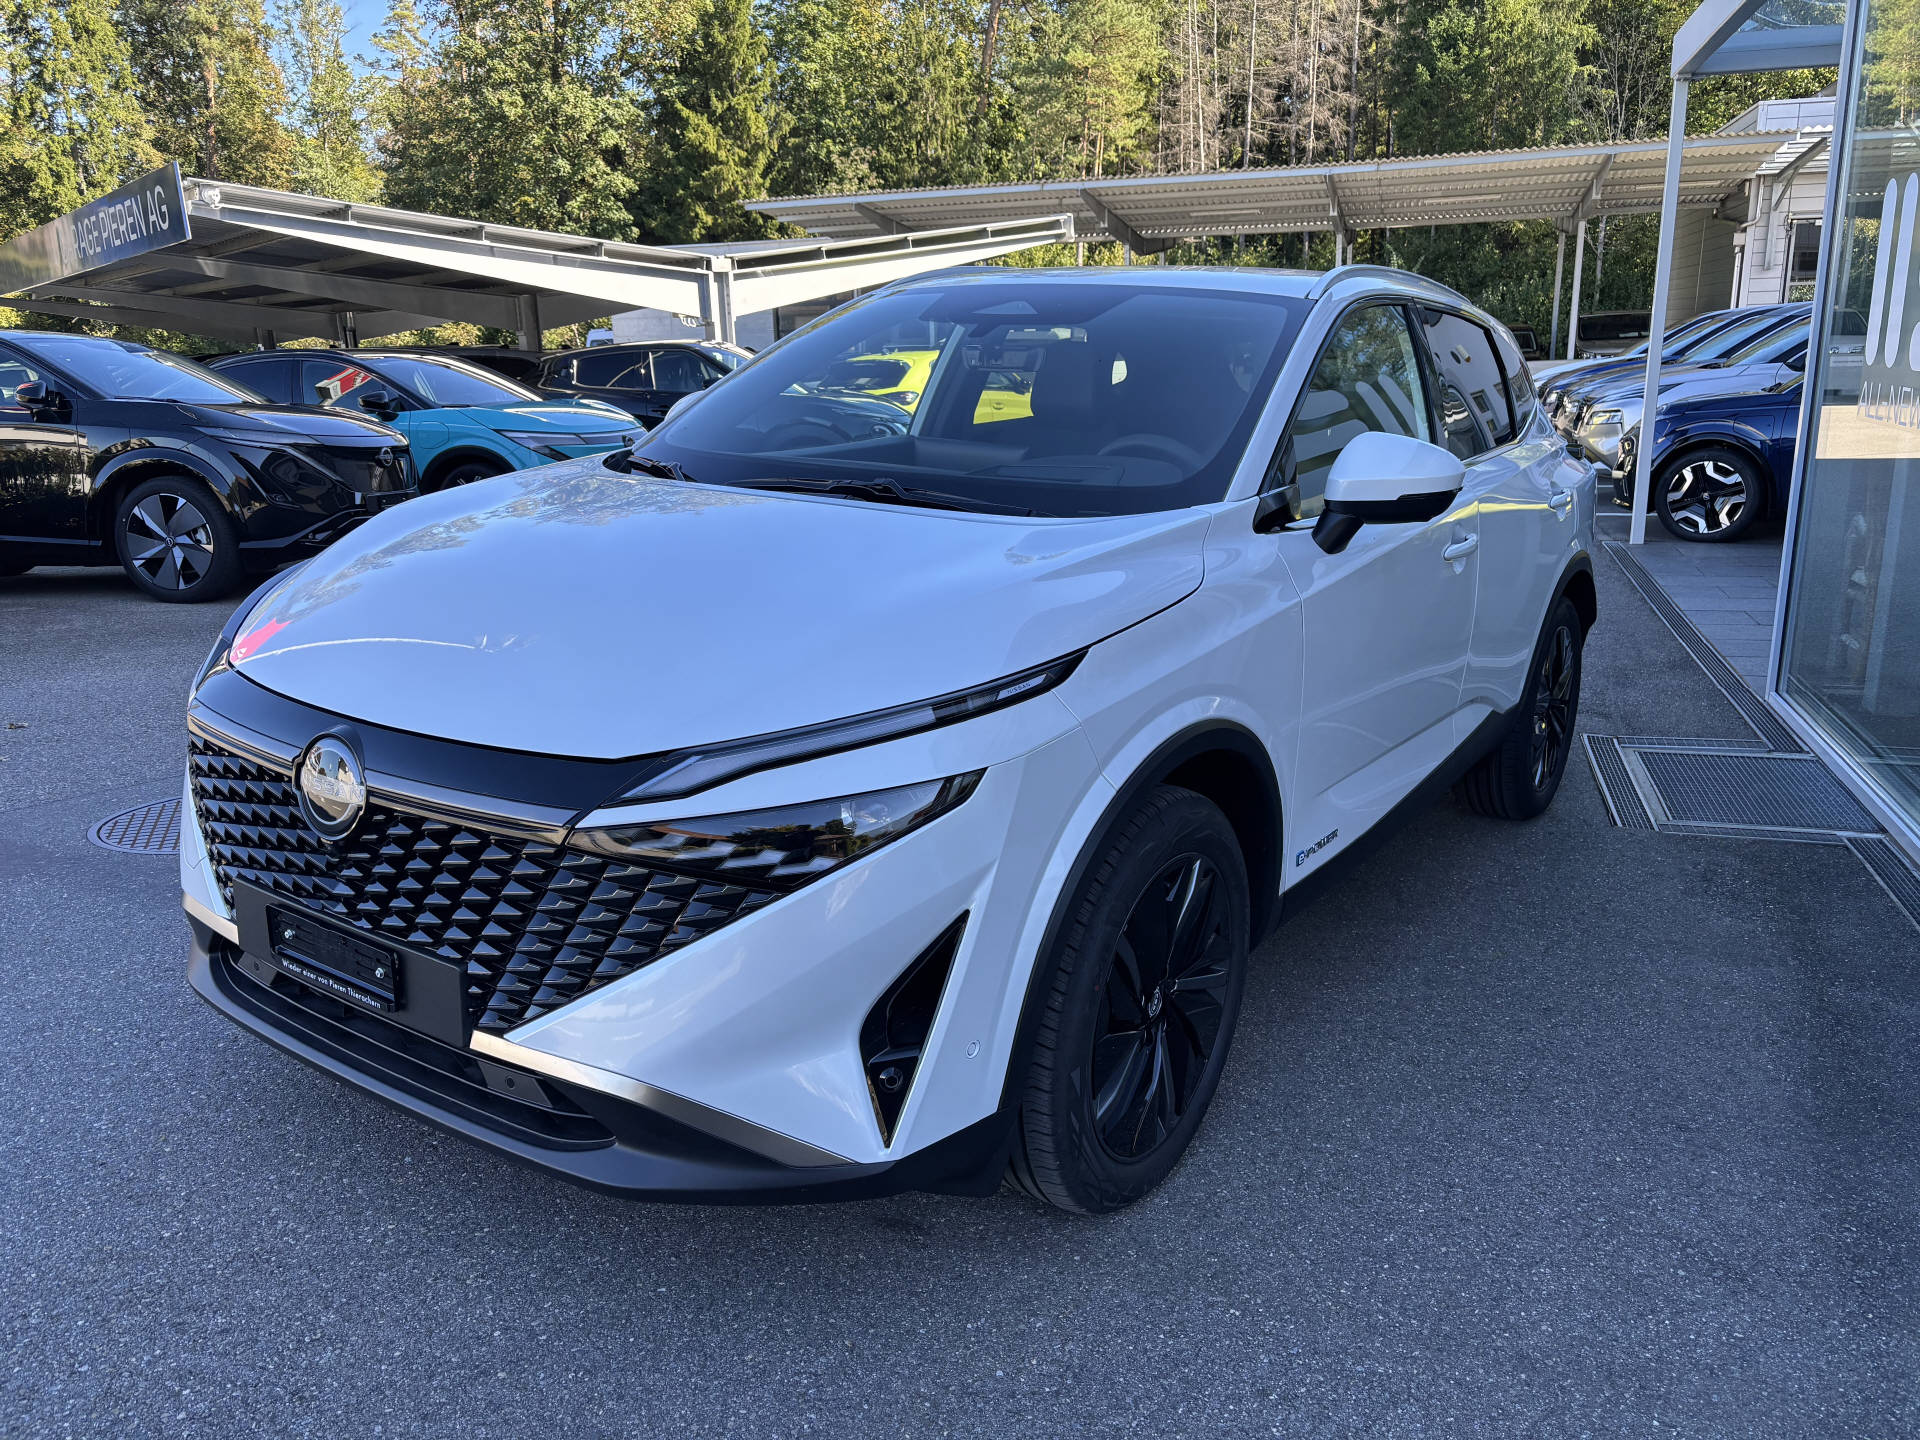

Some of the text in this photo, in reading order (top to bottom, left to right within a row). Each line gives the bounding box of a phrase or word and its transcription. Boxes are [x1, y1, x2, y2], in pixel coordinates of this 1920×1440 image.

[61, 185, 169, 263] RAGE PIEREN AG
[281, 958, 302, 974] Wieder
[317, 975, 328, 985] von
[329, 979, 347, 994] Pieren
[347, 986, 381, 1009] Thierachern
